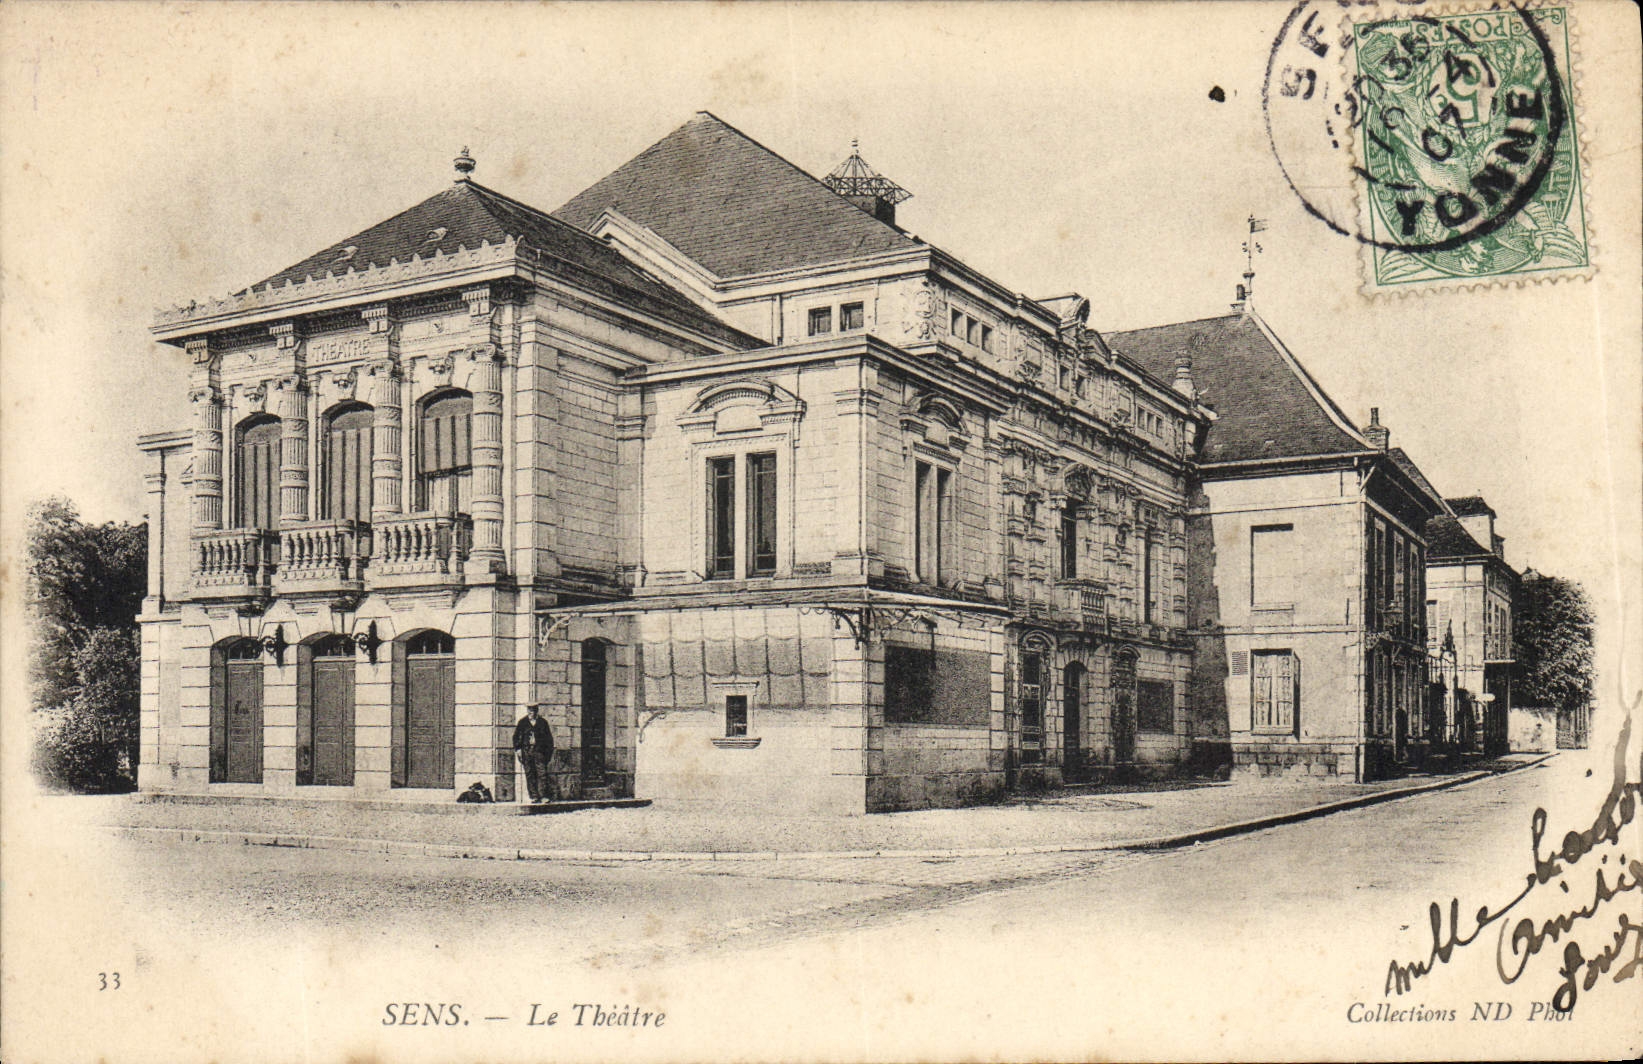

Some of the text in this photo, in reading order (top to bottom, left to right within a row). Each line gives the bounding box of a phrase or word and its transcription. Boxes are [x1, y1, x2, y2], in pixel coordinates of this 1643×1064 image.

[1415, 15, 1512, 43] POSTES
[1395, 87, 1543, 236] YONNE
[98, 972, 121, 991] 33
[382, 1003, 470, 1026] SENS.
[527, 1003, 558, 1026] Le
[572, 1004, 666, 1027] Théâtre
[1347, 1002, 1456, 1023] Collections
[1470, 1002, 1513, 1022] ND
